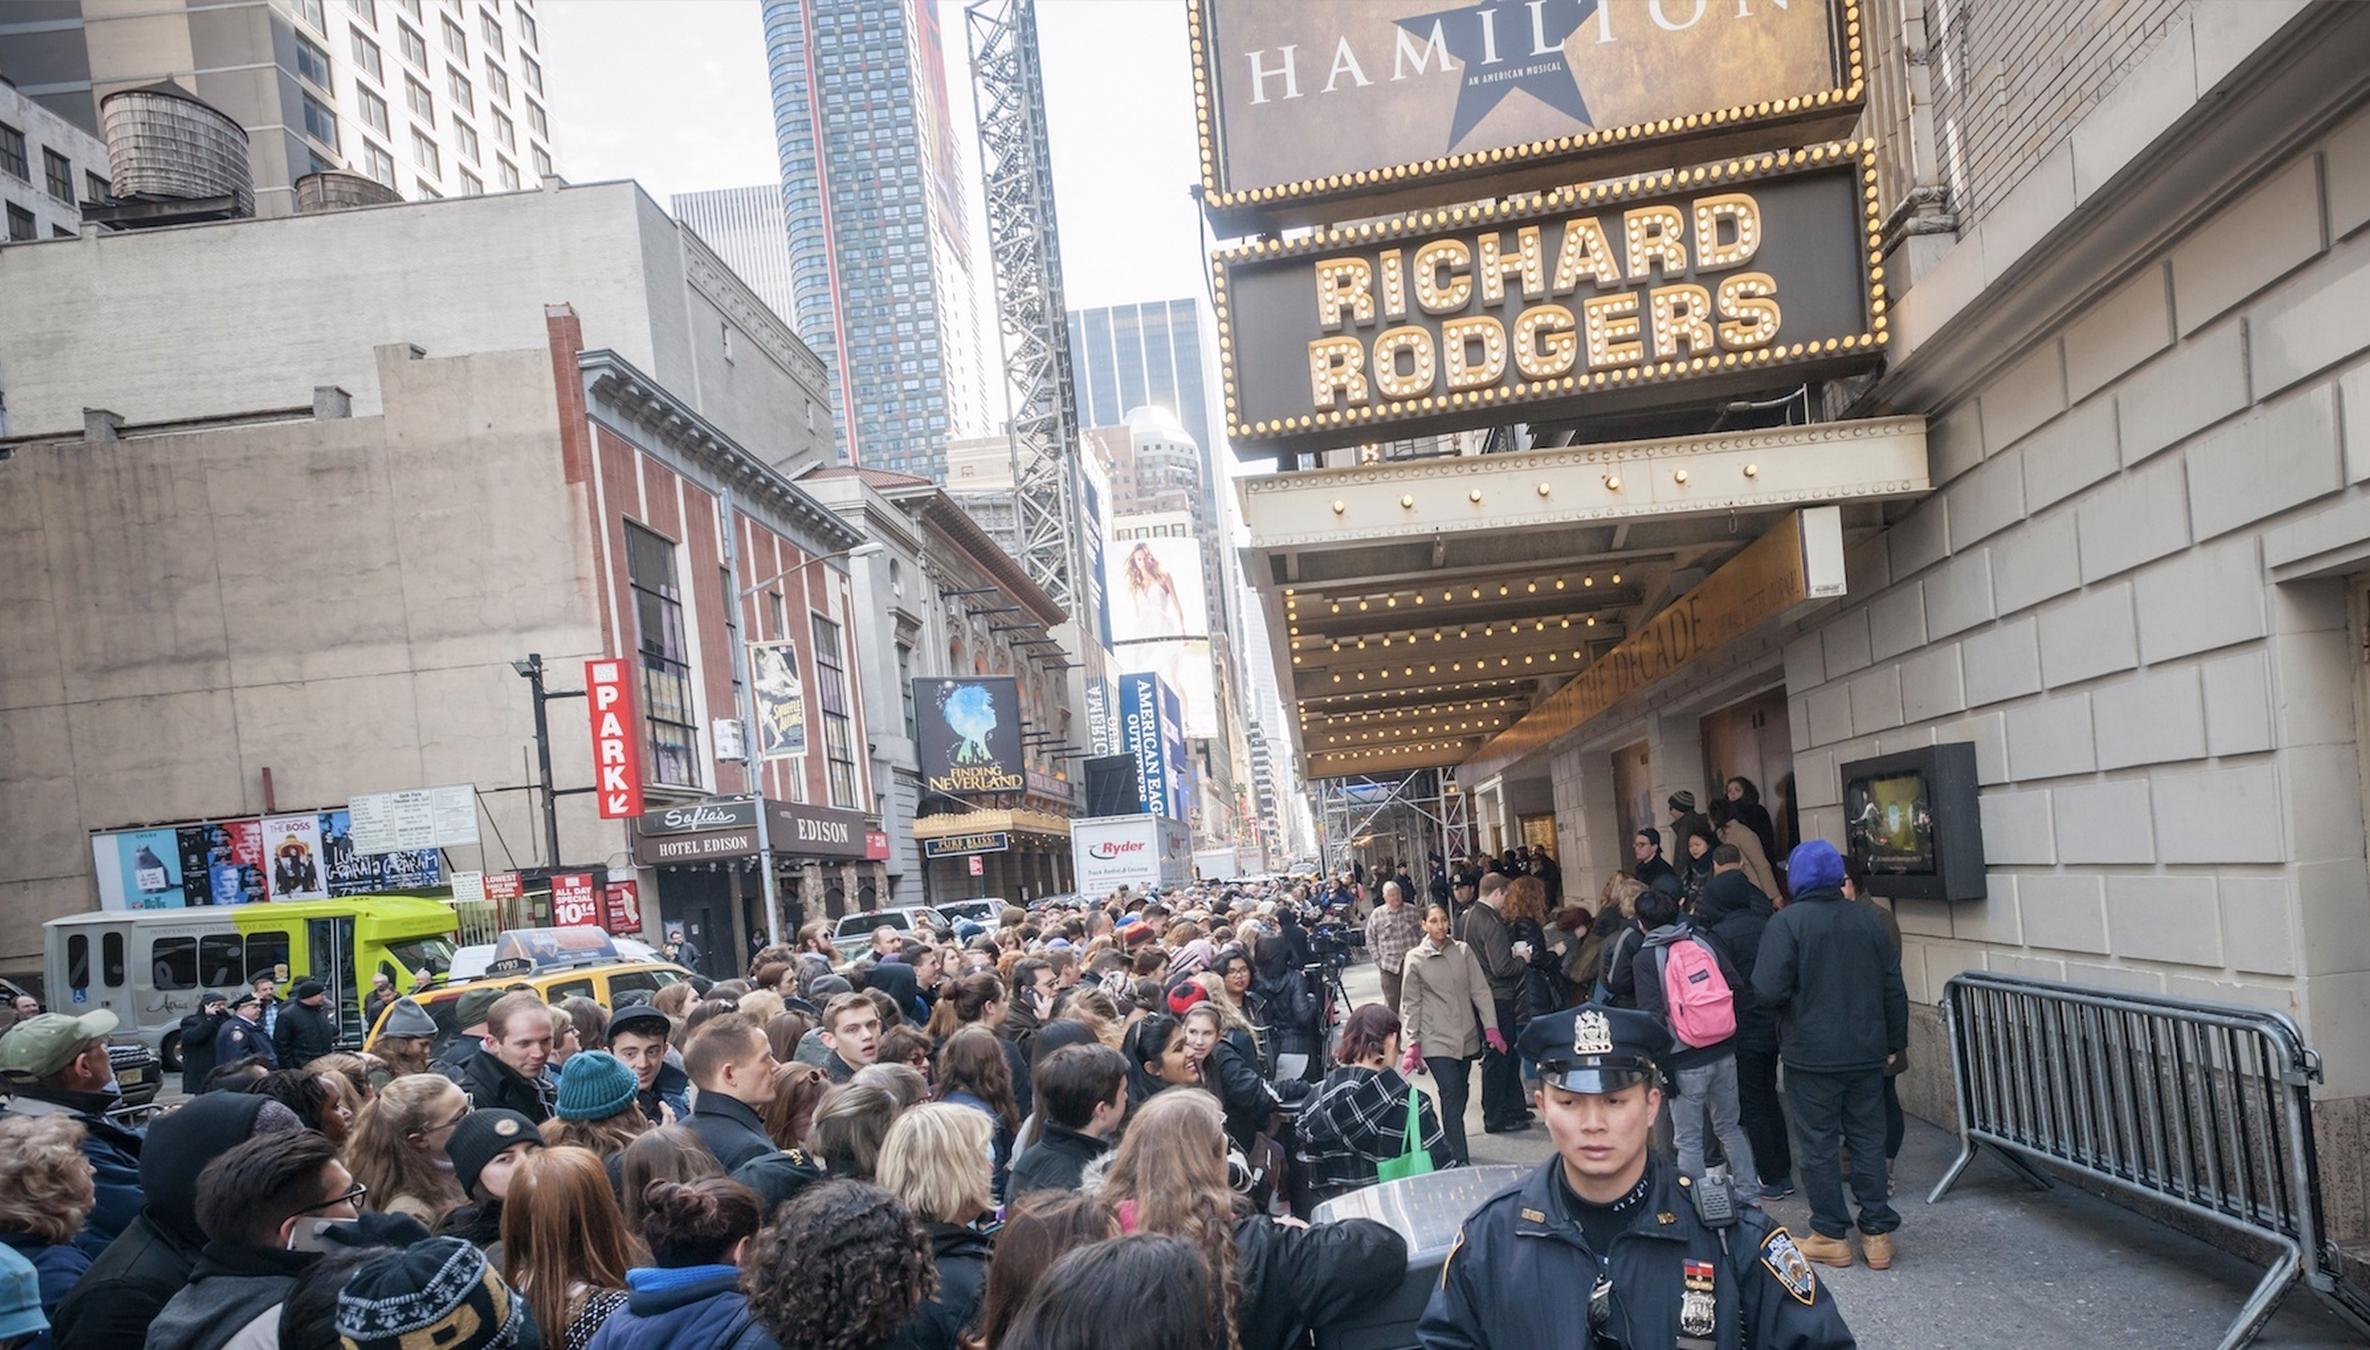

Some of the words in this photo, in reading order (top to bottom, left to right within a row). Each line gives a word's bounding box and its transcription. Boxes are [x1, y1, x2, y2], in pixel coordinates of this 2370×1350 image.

[1469, 76, 1479, 86] AN
[1482, 68, 1523, 83] AMERICAN
[1526, 61, 1561, 76] MUSICAL
[1314, 192, 1762, 332] RICHARD
[1308, 271, 1782, 411] RODGERS
[1614, 594, 1704, 695] DECADE
[595, 685, 630, 792] PARK
[1137, 680, 1160, 774] AMERICAN
[928, 774, 1024, 792] NEVERLAND
[949, 765, 1002, 778] FINDING
[1147, 777, 1165, 816] EAG
[269, 824, 285, 833] THE
[285, 821, 311, 832] BOSS
[664, 806, 737, 830] Sofia's
[796, 818, 849, 843] EDISON
[659, 839, 700, 857] HOTEL
[704, 835, 748, 853] EDISON
[1102, 841, 1146, 855] Ryder
[485, 874, 516, 884] LOWEST
[555, 894, 593, 904] SPECIAL
[556, 888, 572, 896] ALL
[574, 887, 592, 895] DAY
